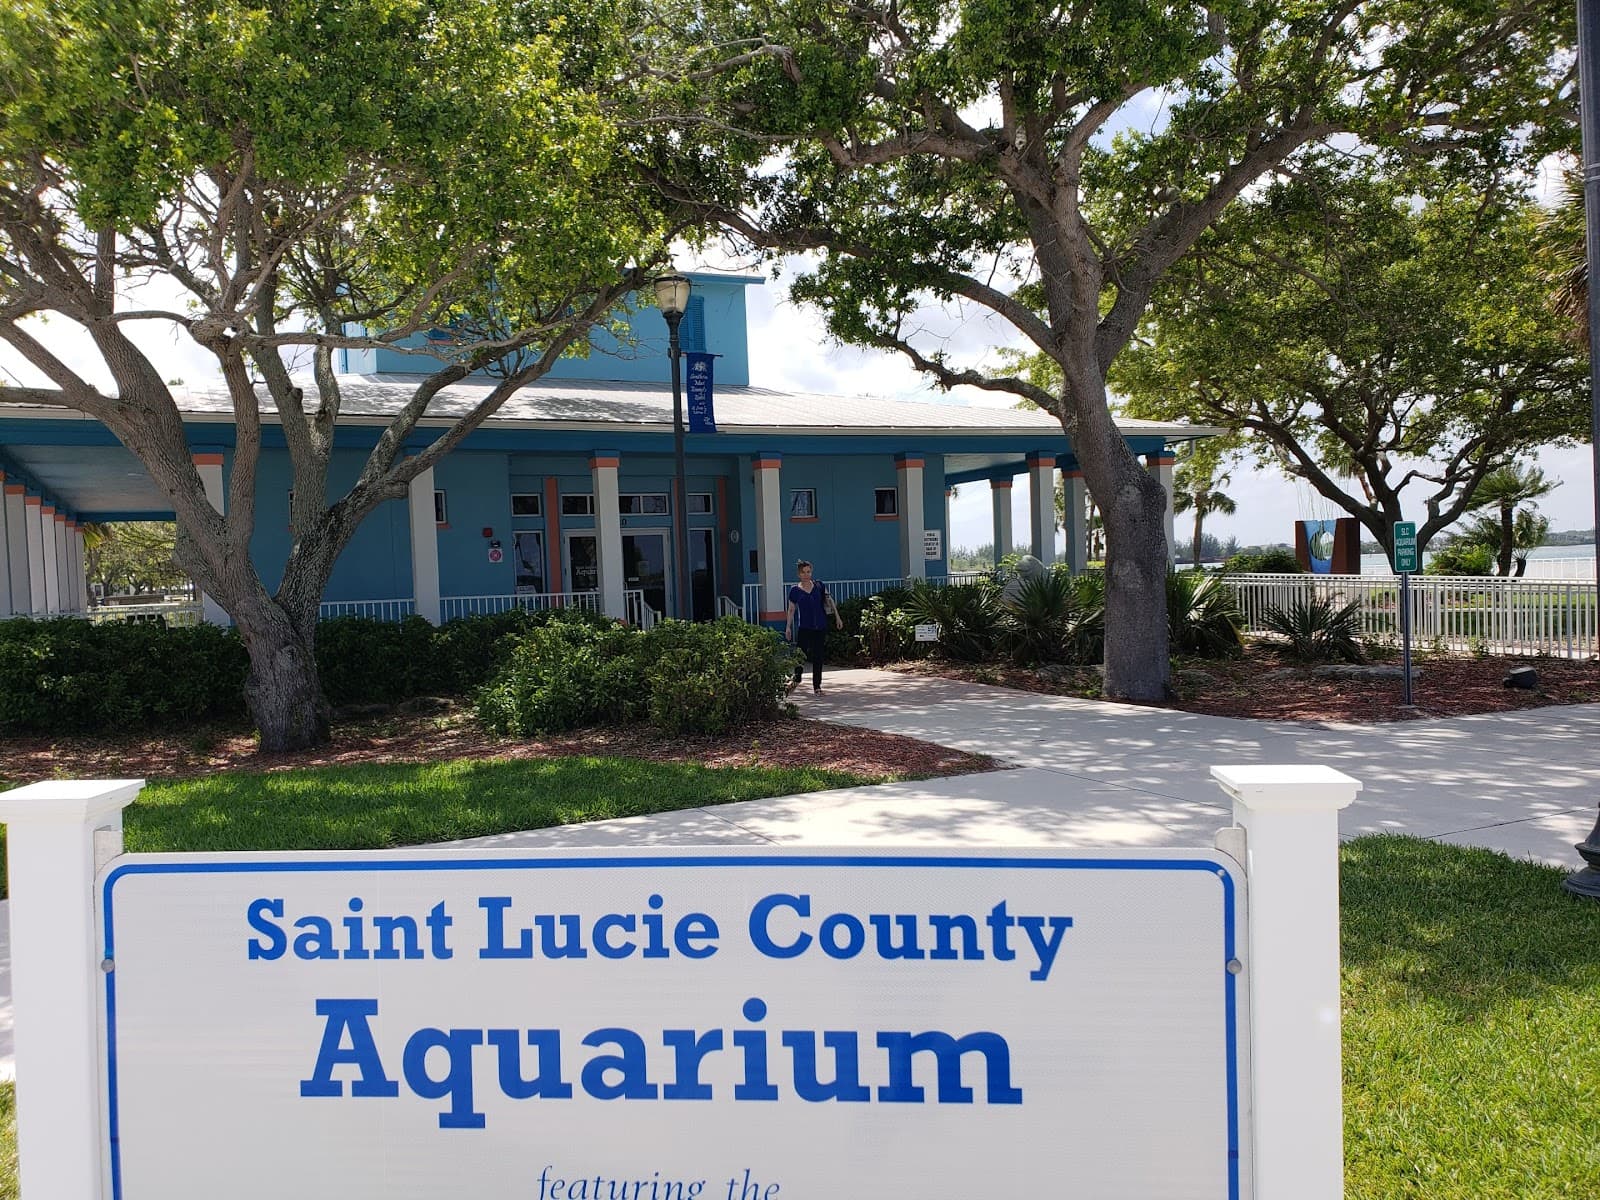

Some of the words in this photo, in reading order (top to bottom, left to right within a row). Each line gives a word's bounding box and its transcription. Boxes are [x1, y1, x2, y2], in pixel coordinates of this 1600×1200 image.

[1401, 527, 1409, 536] SLC
[247, 897, 453, 961] Saint
[478, 894, 720, 959] Lucie
[749, 893, 1073, 982] County
[300, 998, 1023, 1129] Aquarium
[537, 1165, 706, 1200] featuring
[727, 1168, 780, 1200] the
